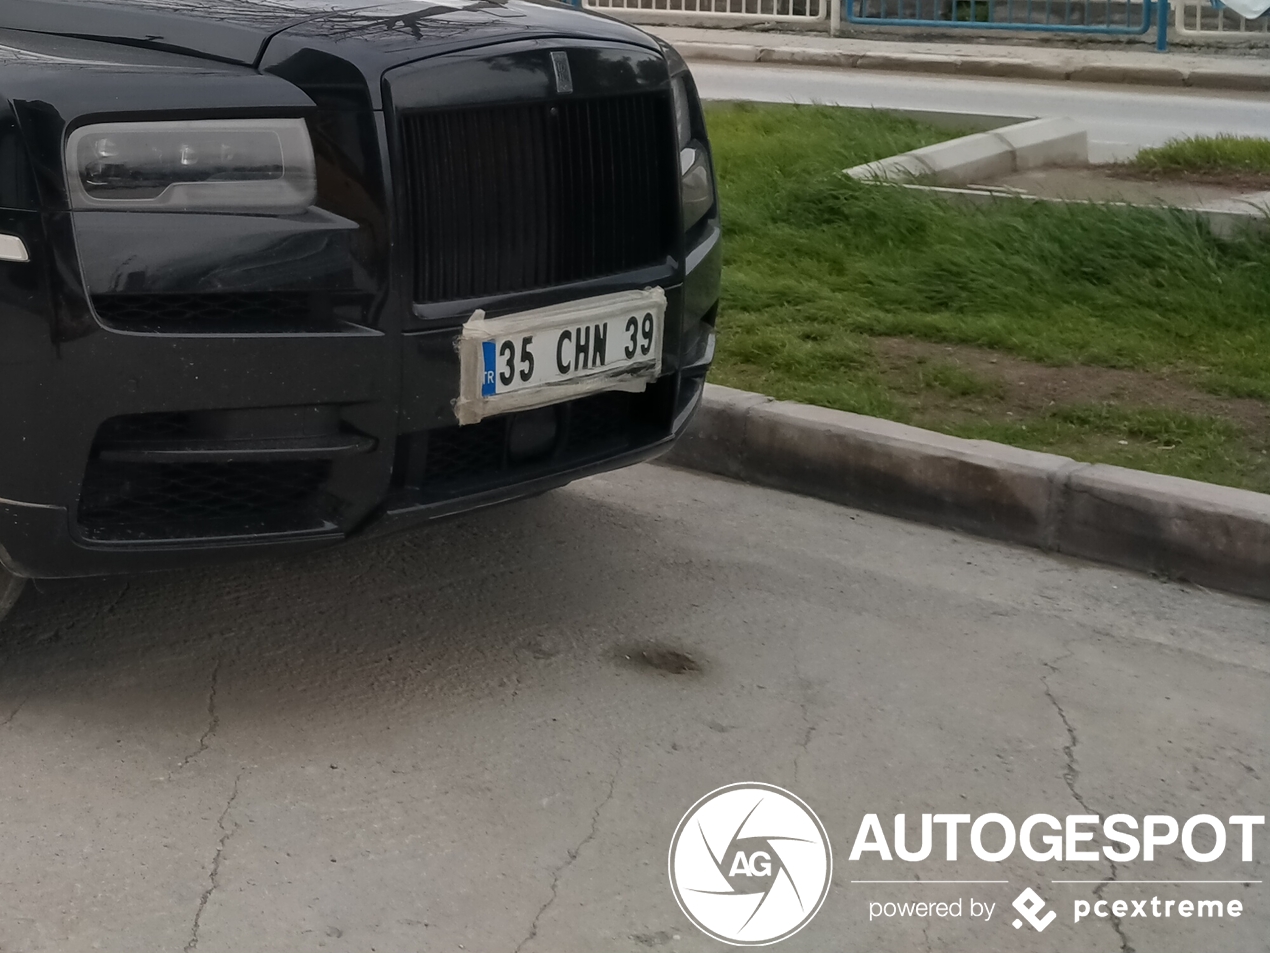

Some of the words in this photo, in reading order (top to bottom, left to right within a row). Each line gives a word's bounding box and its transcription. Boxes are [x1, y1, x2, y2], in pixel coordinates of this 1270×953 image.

[499, 336, 534, 386] 35
[556, 322, 608, 374] CHN
[624, 312, 654, 359] 39
